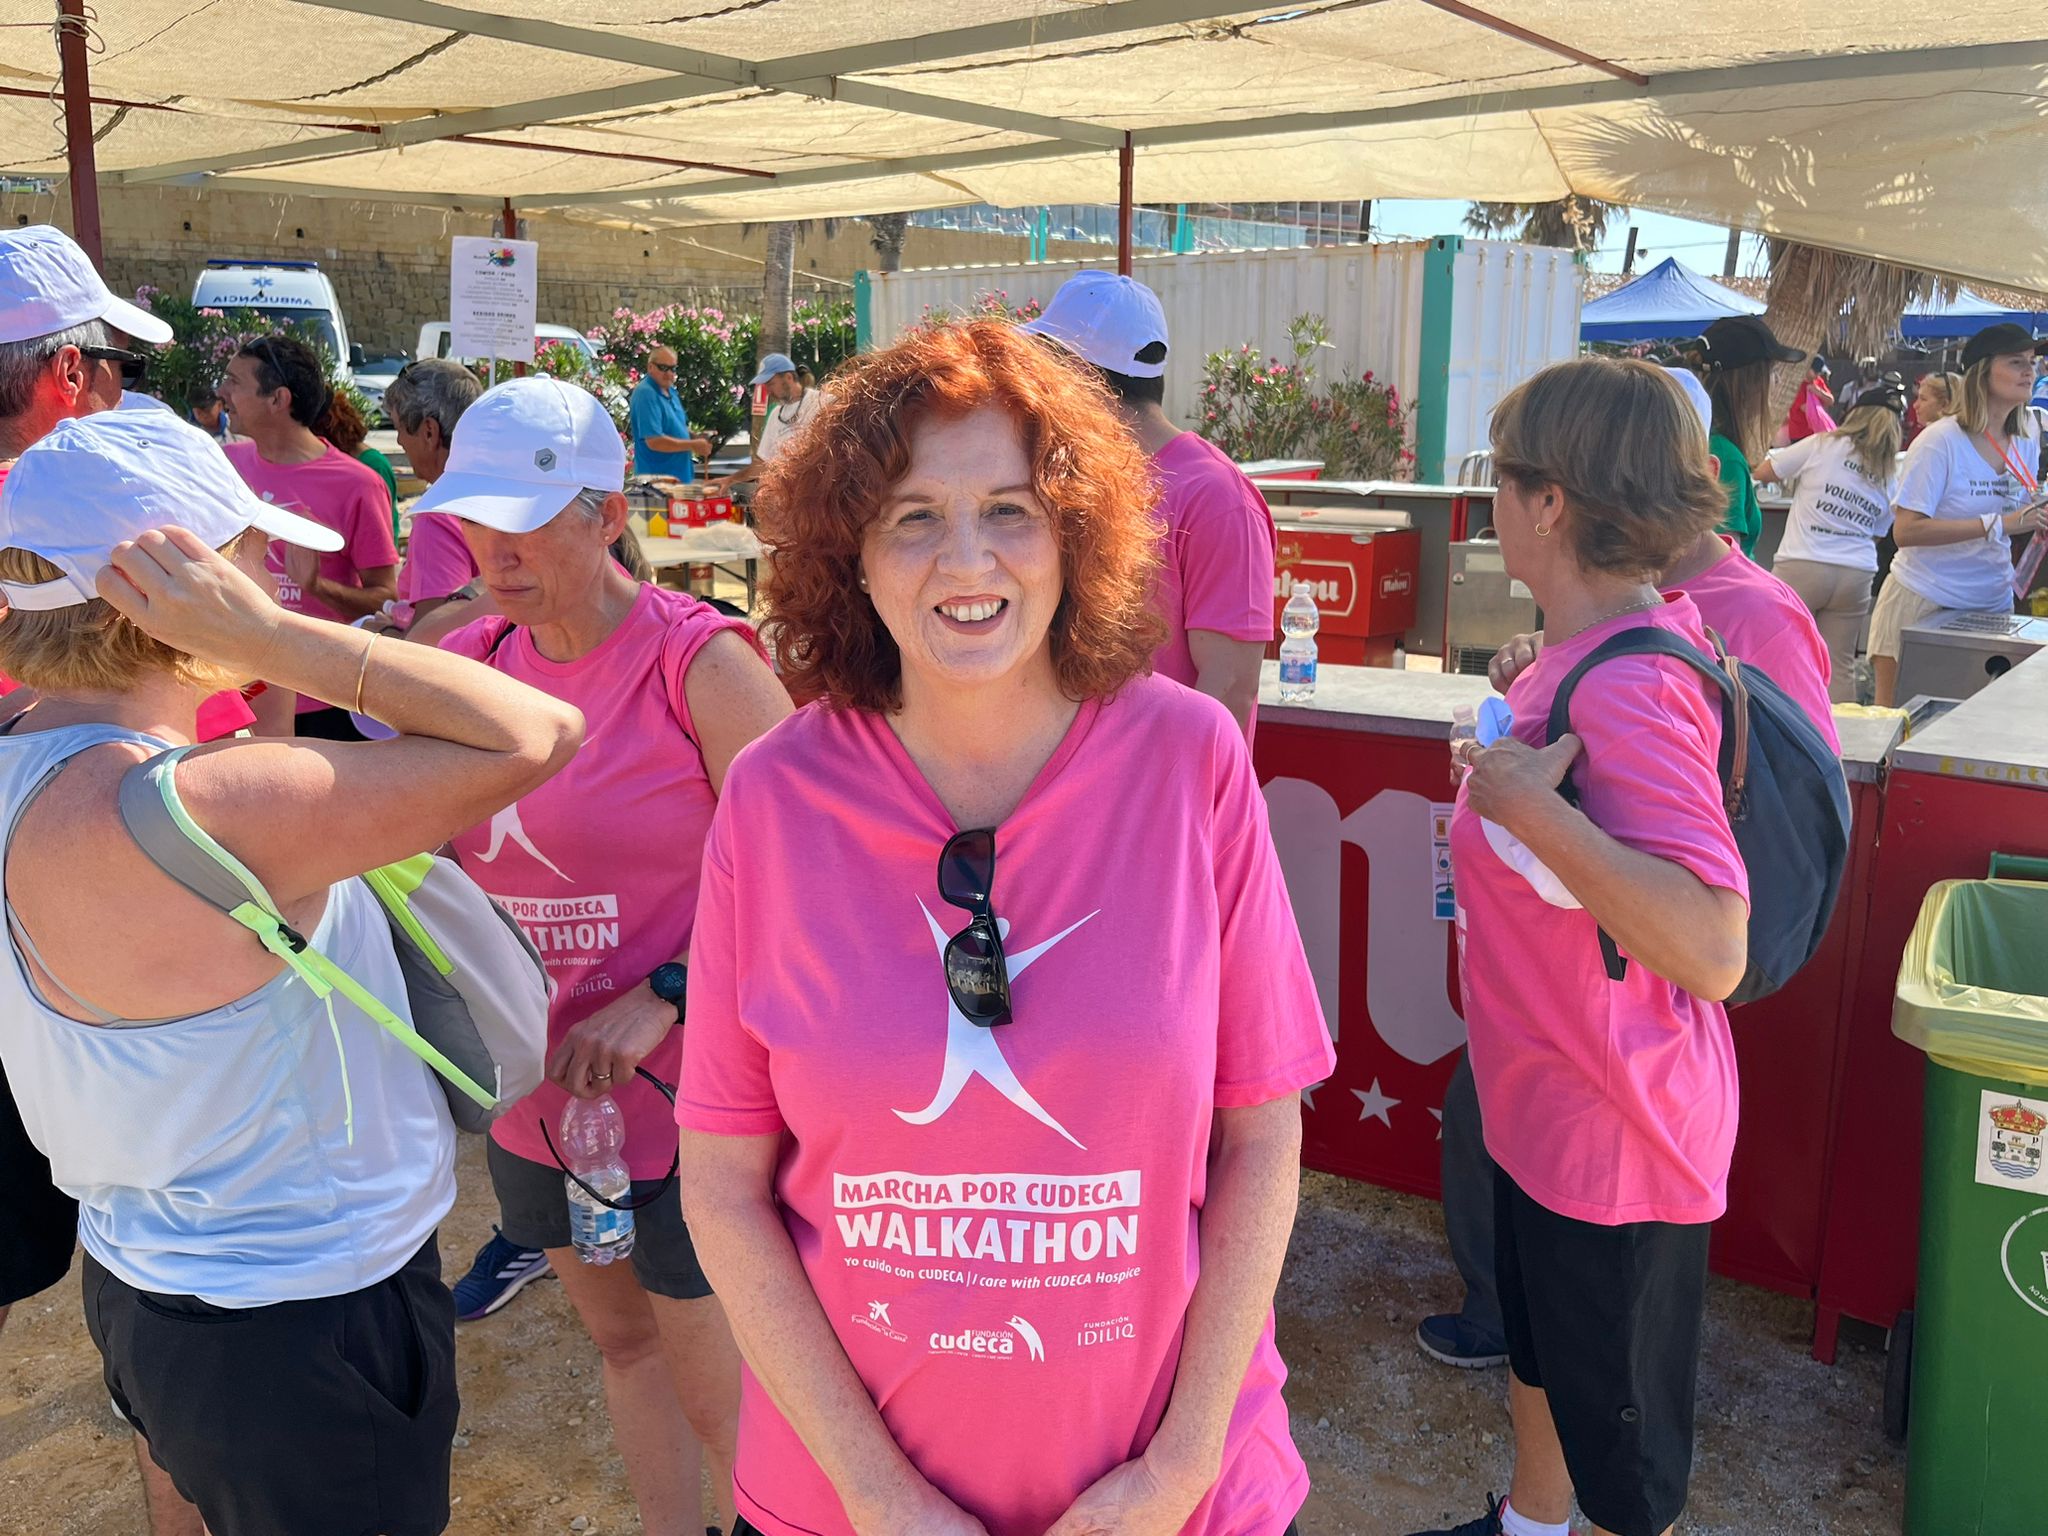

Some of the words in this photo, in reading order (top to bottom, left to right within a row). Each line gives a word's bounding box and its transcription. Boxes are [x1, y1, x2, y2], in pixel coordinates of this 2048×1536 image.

[1383, 577, 1408, 593] Mahou
[1939, 755, 2048, 782] Event
[513, 902, 538, 917] POR
[542, 900, 606, 918] CUDECA
[563, 957, 588, 966] CUDECA
[570, 978, 616, 998] IDILIQ
[841, 1179, 952, 1204] MARCHA
[962, 1181, 1017, 1204] POR
[1025, 1180, 1123, 1207] CUDECA
[834, 1211, 1139, 1264] WALKATHON
[844, 1257, 859, 1267] Yo
[863, 1257, 892, 1274] cuido
[894, 1266, 915, 1279] con
[918, 1269, 964, 1284] CUDECA
[979, 1276, 1007, 1288] care
[1011, 1276, 1040, 1289] with
[1044, 1273, 1092, 1288] CUDECA
[1095, 1266, 1141, 1284] Hospice
[2028, 1285, 2040, 1296] NO
[1084, 1316, 1129, 1328] FUNDACIÓN
[929, 1330, 1014, 1354] cudeca
[971, 1329, 1014, 1339] FUNDACIÓN
[1077, 1323, 1136, 1346] IDILIQ
